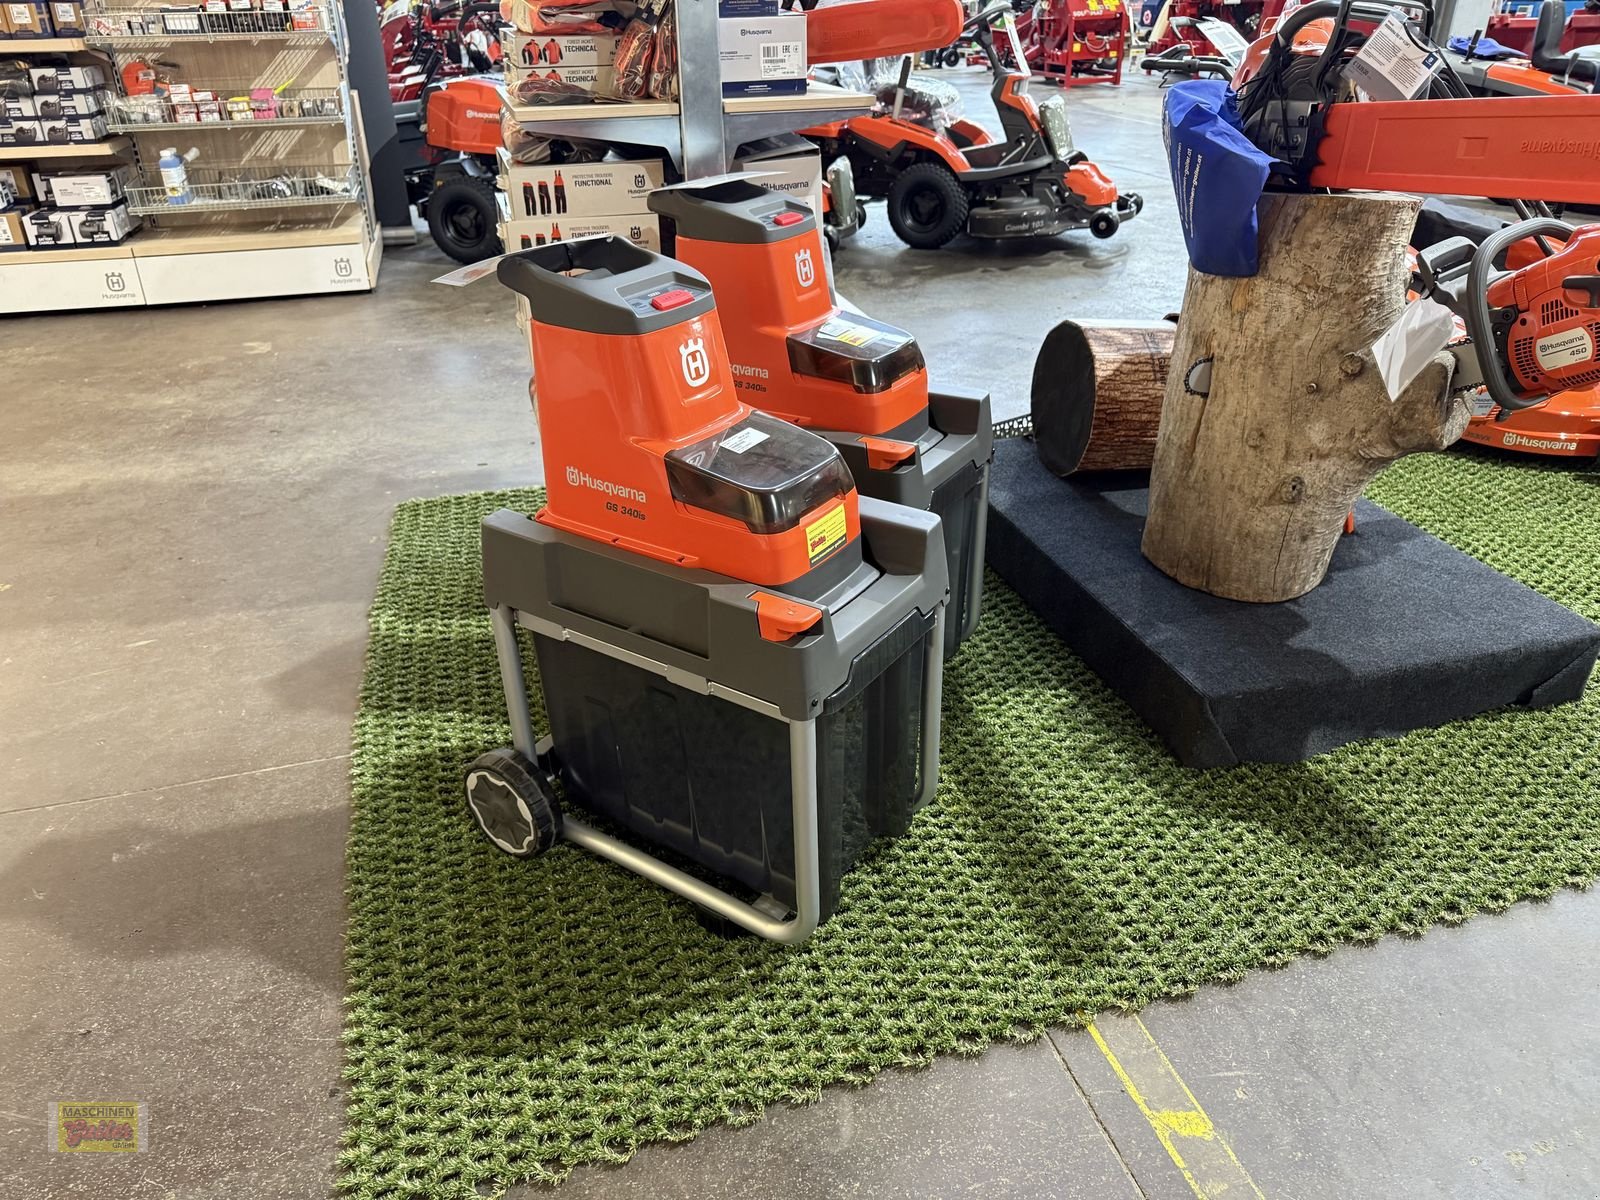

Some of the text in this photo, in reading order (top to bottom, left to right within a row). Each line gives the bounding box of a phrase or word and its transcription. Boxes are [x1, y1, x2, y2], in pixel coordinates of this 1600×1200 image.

[745, 29, 773, 37] Husqvarna
[564, 45, 598, 53] TECHNICAL
[564, 75, 598, 83] TECHNICAL
[574, 179, 613, 188] FUNCTIONAL
[769, 180, 809, 191] Husqvarna
[1547, 334, 1585, 351] Husqvarna
[1569, 346, 1587, 356] 450
[730, 363, 769, 379] qvarna
[1515, 436, 1578, 451] Husqvarna
[579, 471, 647, 504] Husqvarna
[605, 501, 647, 521] GS 340is
